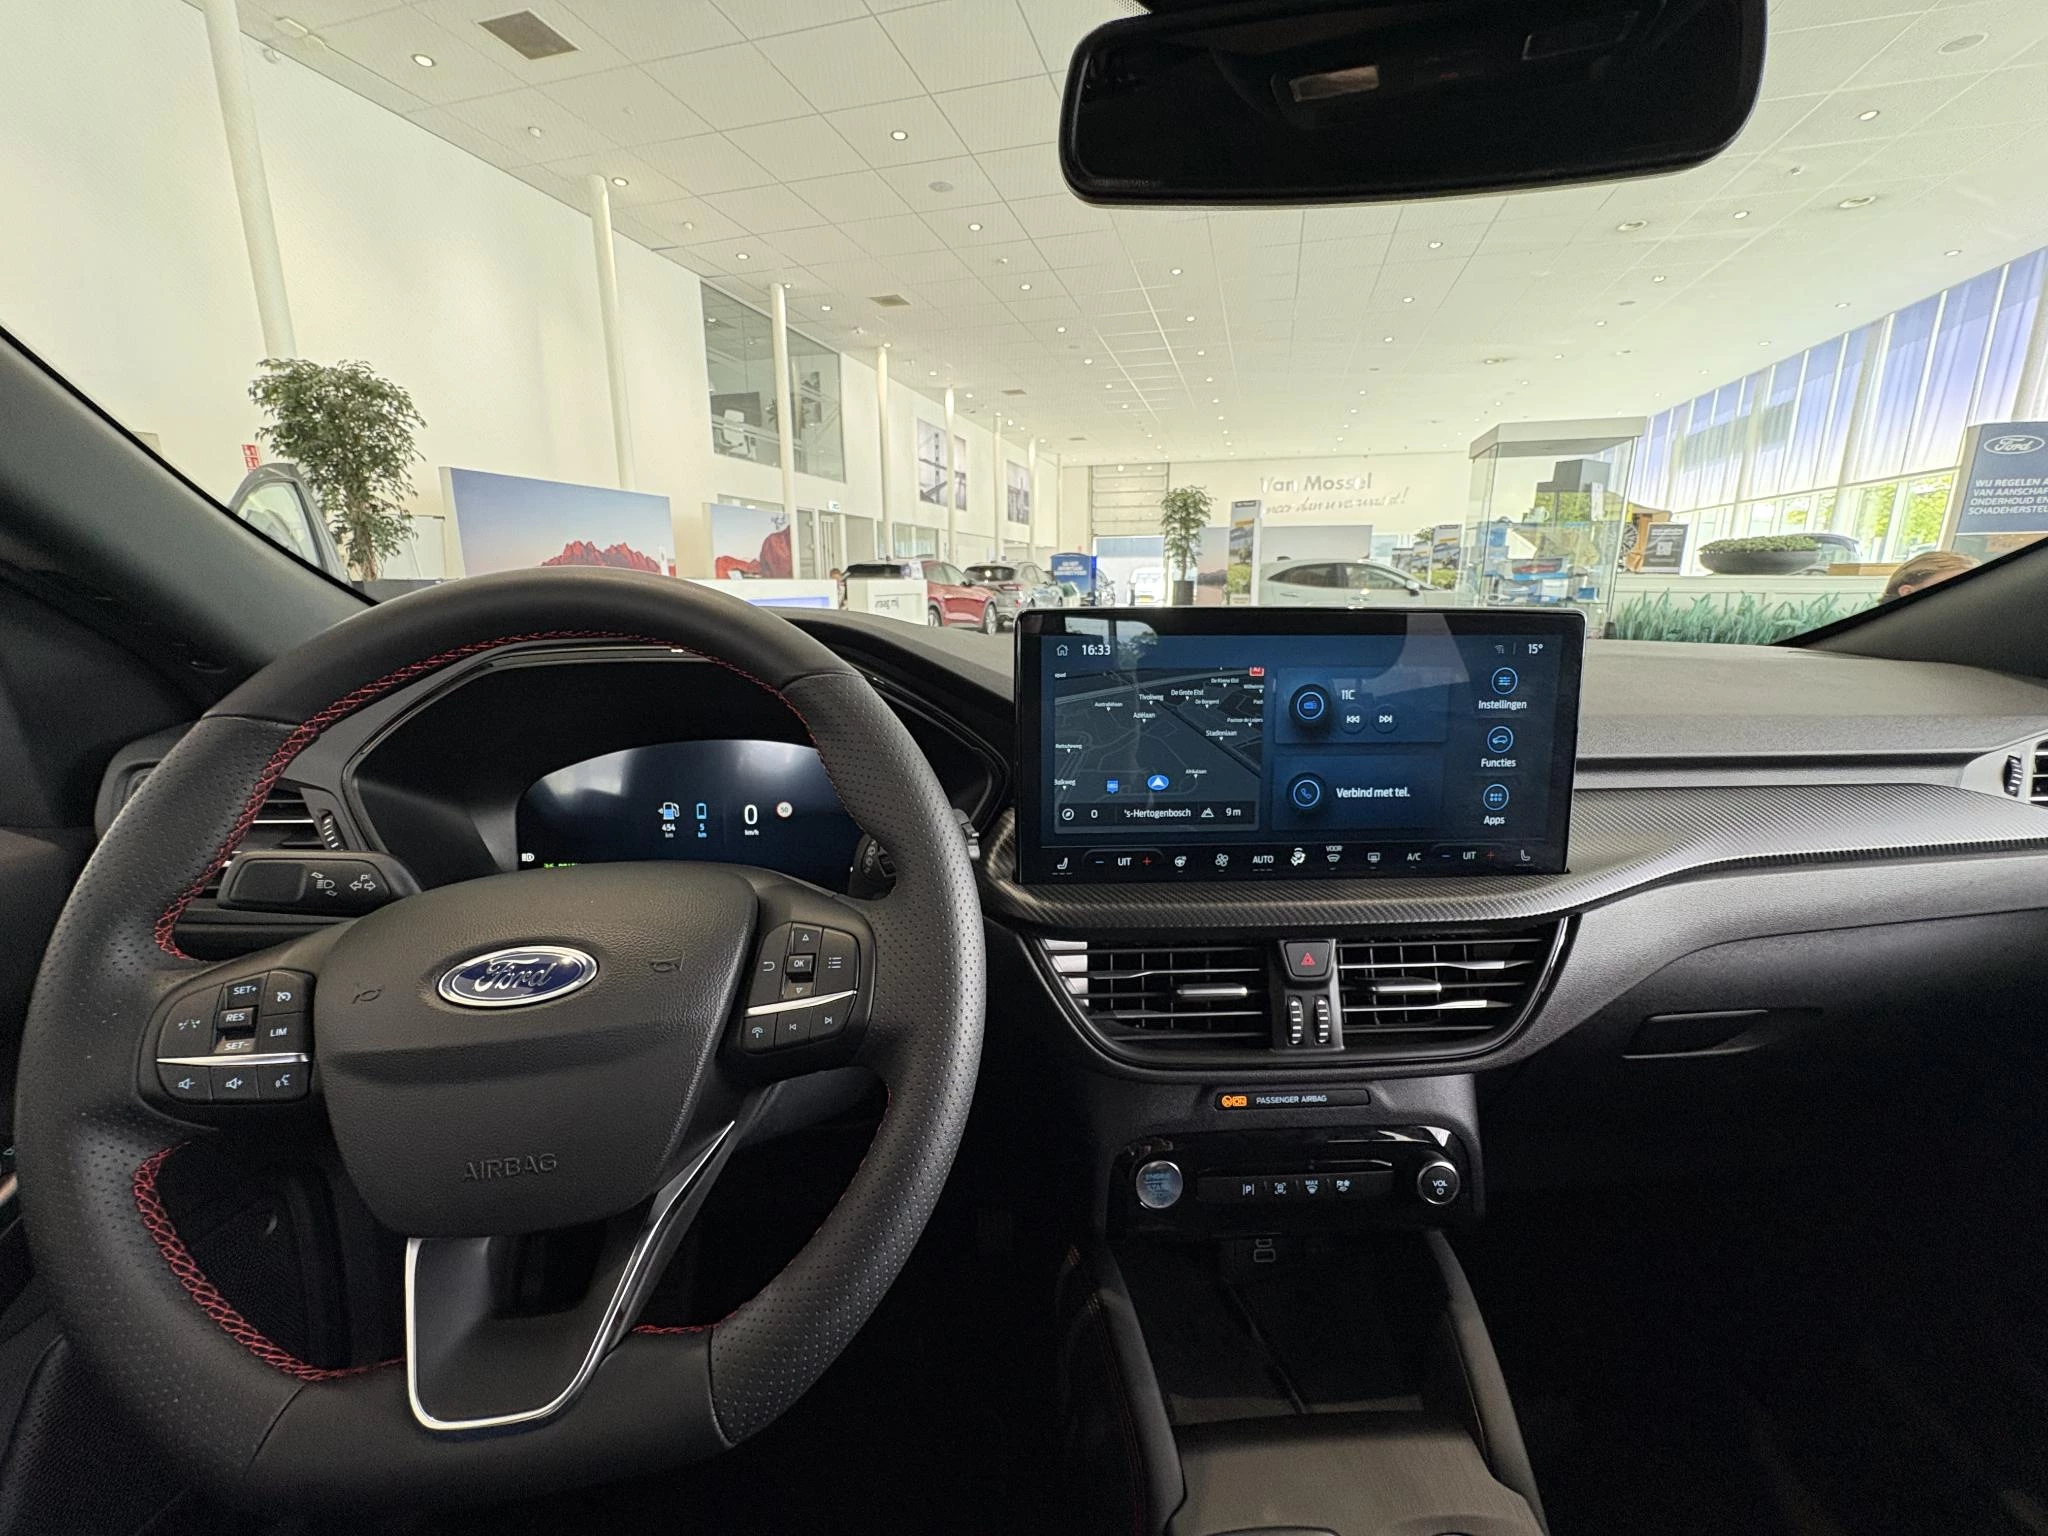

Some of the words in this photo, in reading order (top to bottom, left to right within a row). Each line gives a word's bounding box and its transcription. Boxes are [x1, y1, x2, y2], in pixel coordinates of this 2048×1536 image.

[1994, 478, 2041, 487] REGELEN
[1973, 488, 1994, 496] VAN
[1970, 497, 2034, 506] ONDERHOUD
[1082, 644, 1111, 656] 16:33
[1478, 700, 1527, 710] Instellingen
[1481, 758, 1516, 768] Functies
[1336, 787, 1373, 798] Verbind
[1374, 788, 1393, 797] met
[1395, 787, 1410, 797] tel.
[1124, 808, 1191, 819] 's-Hertogenbosch
[1225, 808, 1232, 816] 9
[1484, 816, 1505, 825] Apps
[661, 823, 676, 831] 454
[1252, 856, 1274, 864] AUTO
[1407, 853, 1421, 861] A/C
[1463, 851, 1476, 860] UIT
[1118, 857, 1132, 866] UIT
[473, 957, 558, 992] Ford
[226, 1013, 245, 1022] RES
[270, 1028, 287, 1036] LIM
[1256, 1096, 1299, 1104] PASSENGER
[463, 1153, 558, 1182] AIRBAG
